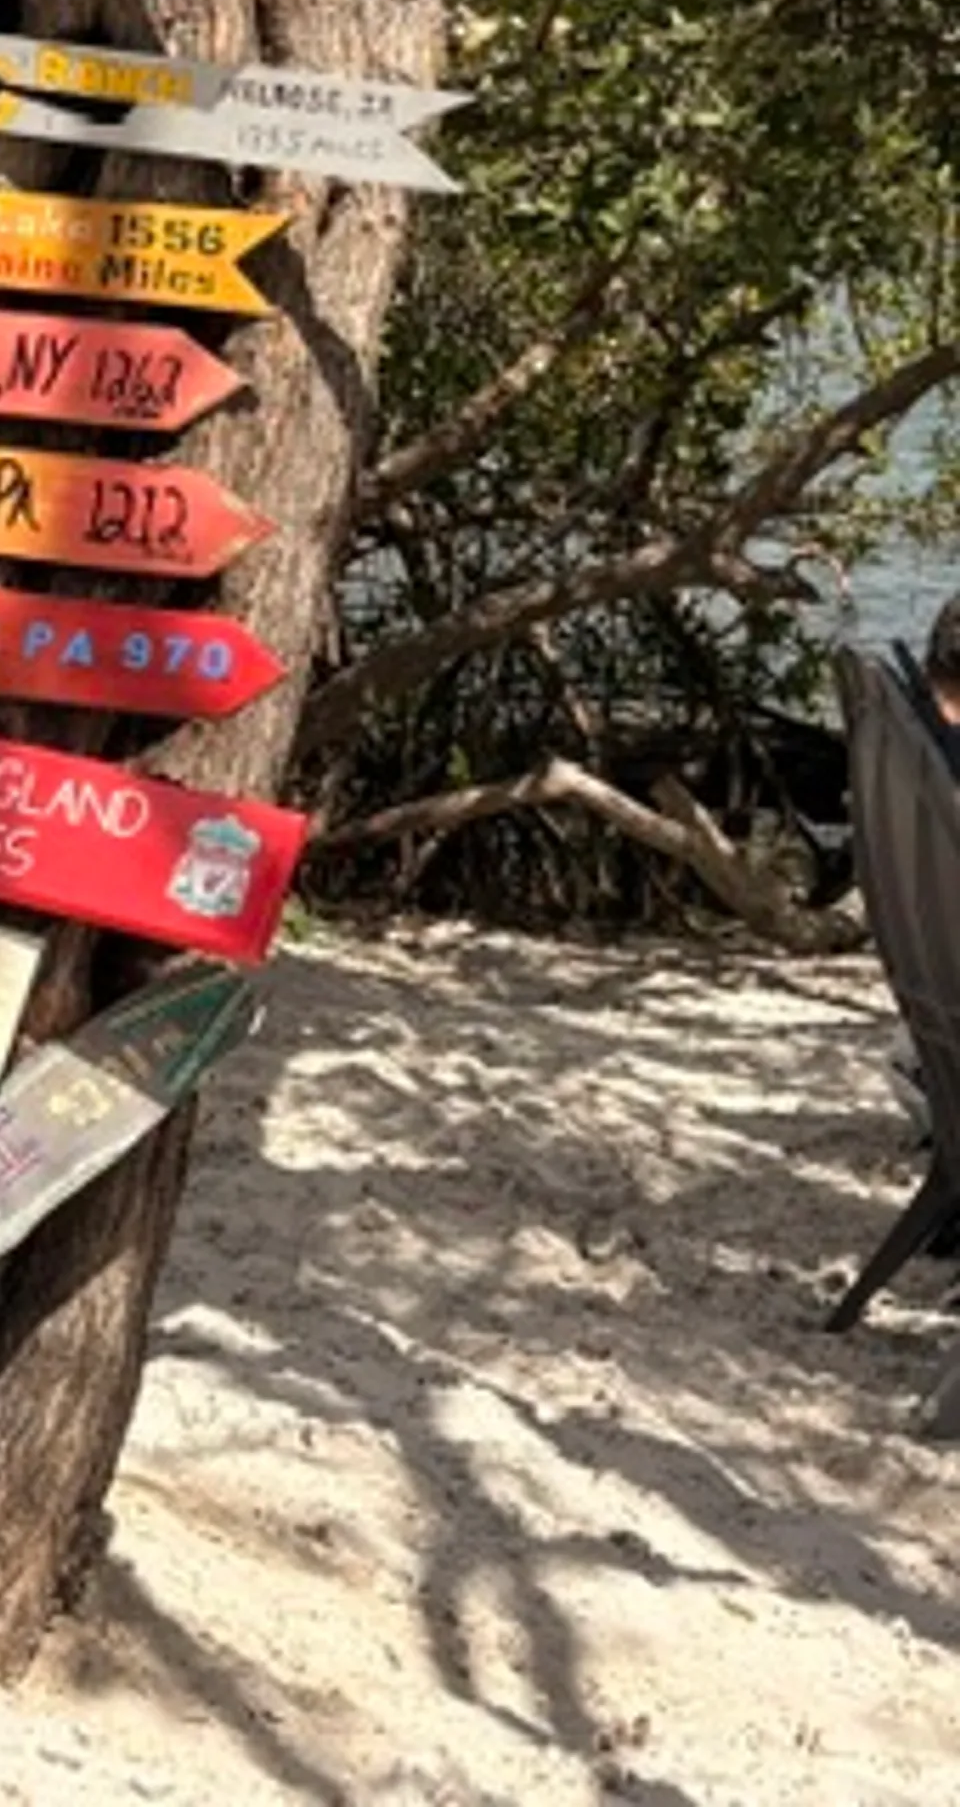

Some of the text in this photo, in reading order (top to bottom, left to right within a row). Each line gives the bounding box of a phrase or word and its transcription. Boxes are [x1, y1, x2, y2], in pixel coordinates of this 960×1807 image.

[106, 212, 226, 256] 1556
[96, 253, 217, 297] Miles
[22, 620, 96, 669] PA
[121, 632, 234, 681] 970
